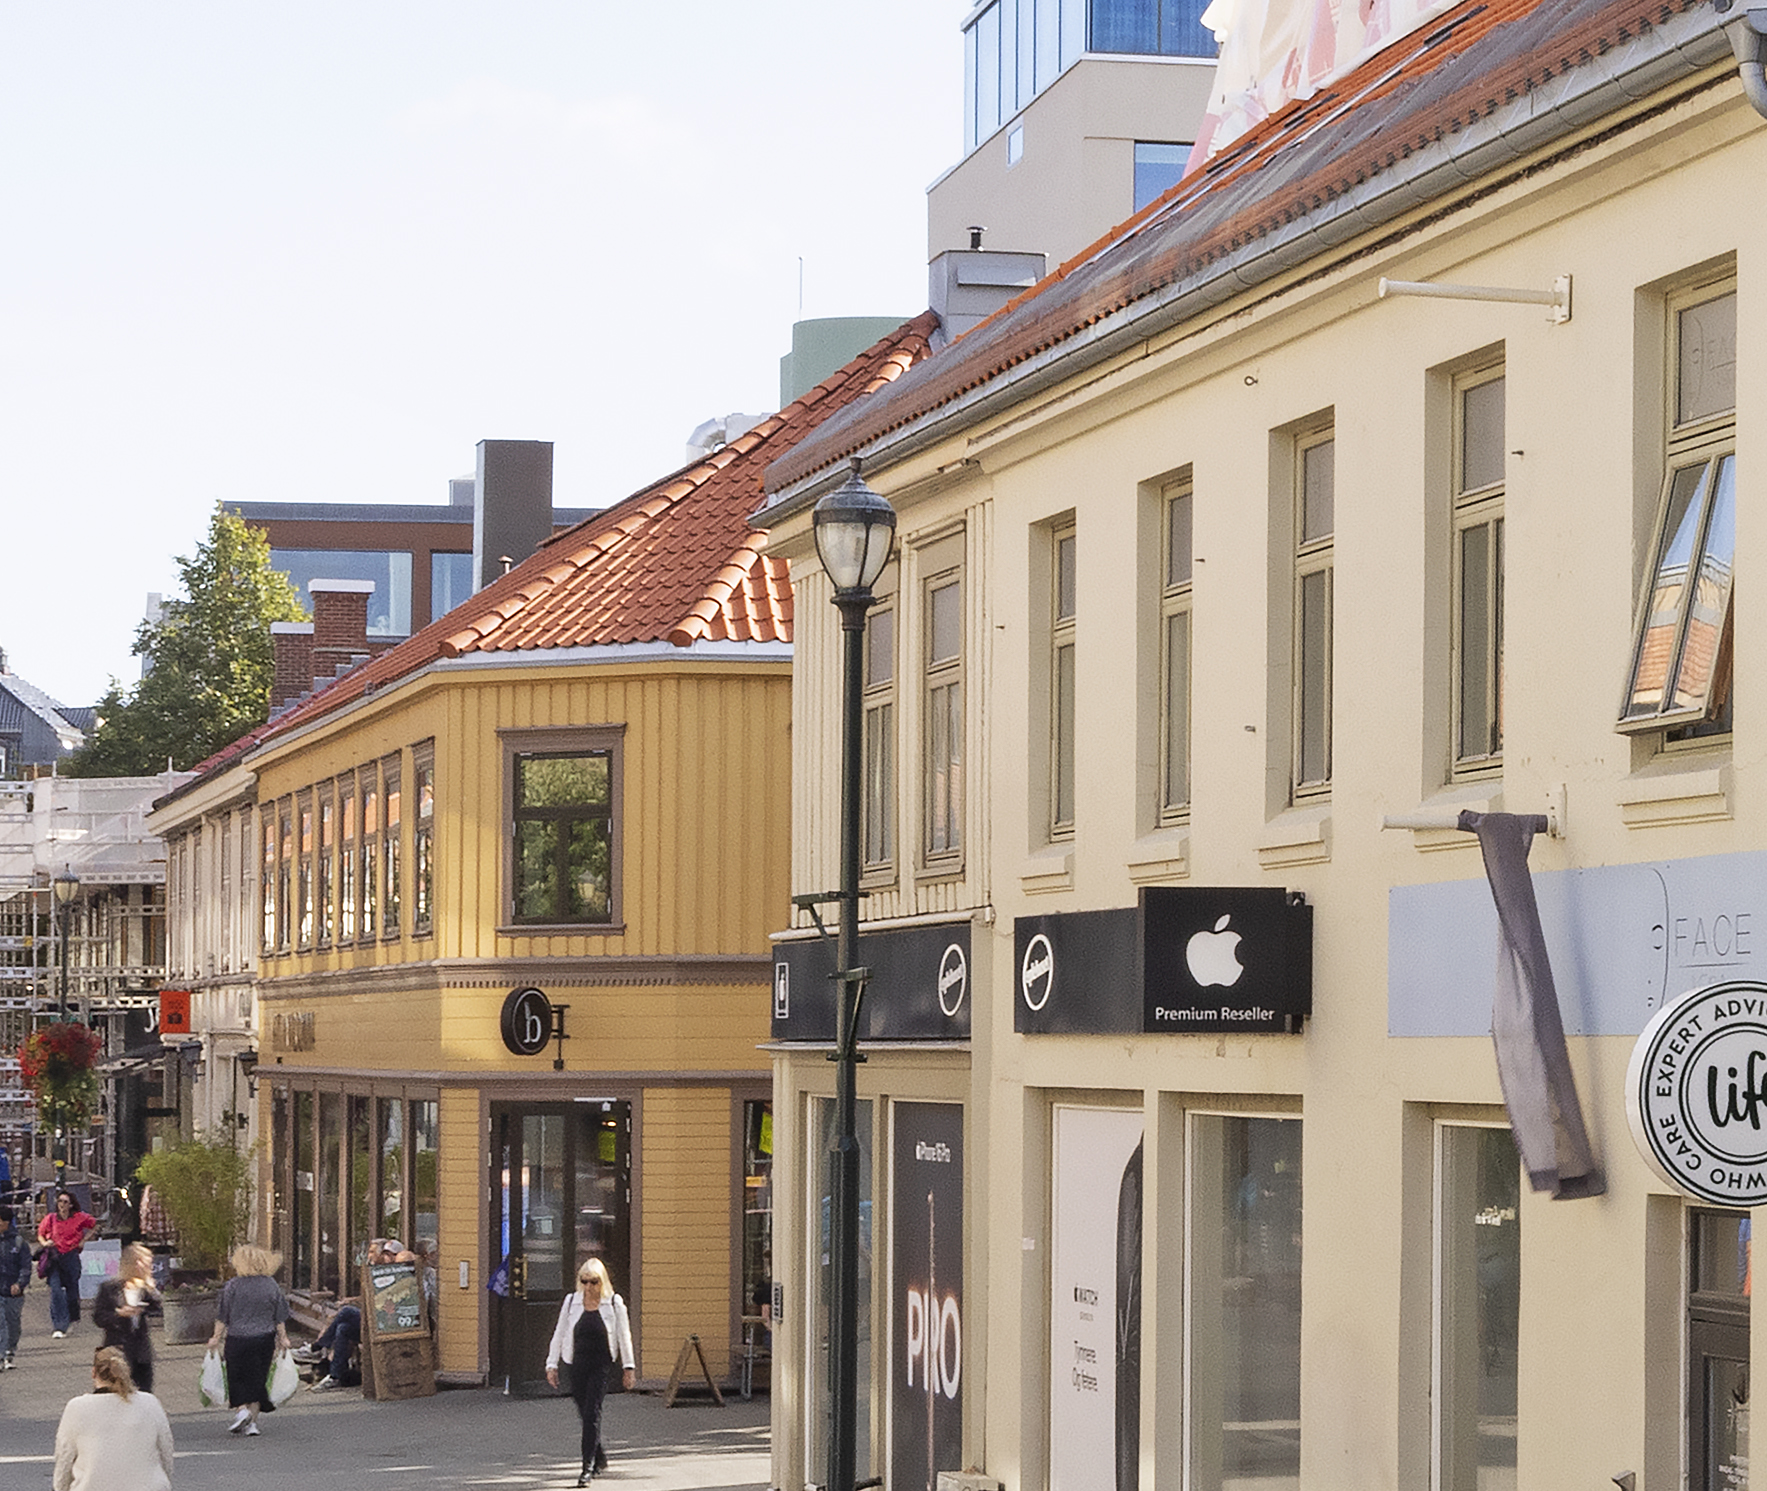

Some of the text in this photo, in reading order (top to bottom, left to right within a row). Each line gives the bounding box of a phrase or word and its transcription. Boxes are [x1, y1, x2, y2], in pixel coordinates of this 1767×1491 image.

[1675, 913, 1752, 957] FACE
[523, 1001, 541, 1043] b
[1155, 1006, 1275, 1021] Premium Reseller
[1656, 1013, 1703, 1098] EXPERT
[1659, 1113, 1702, 1171] CARE
[1709, 1168, 1767, 1190] WHO
